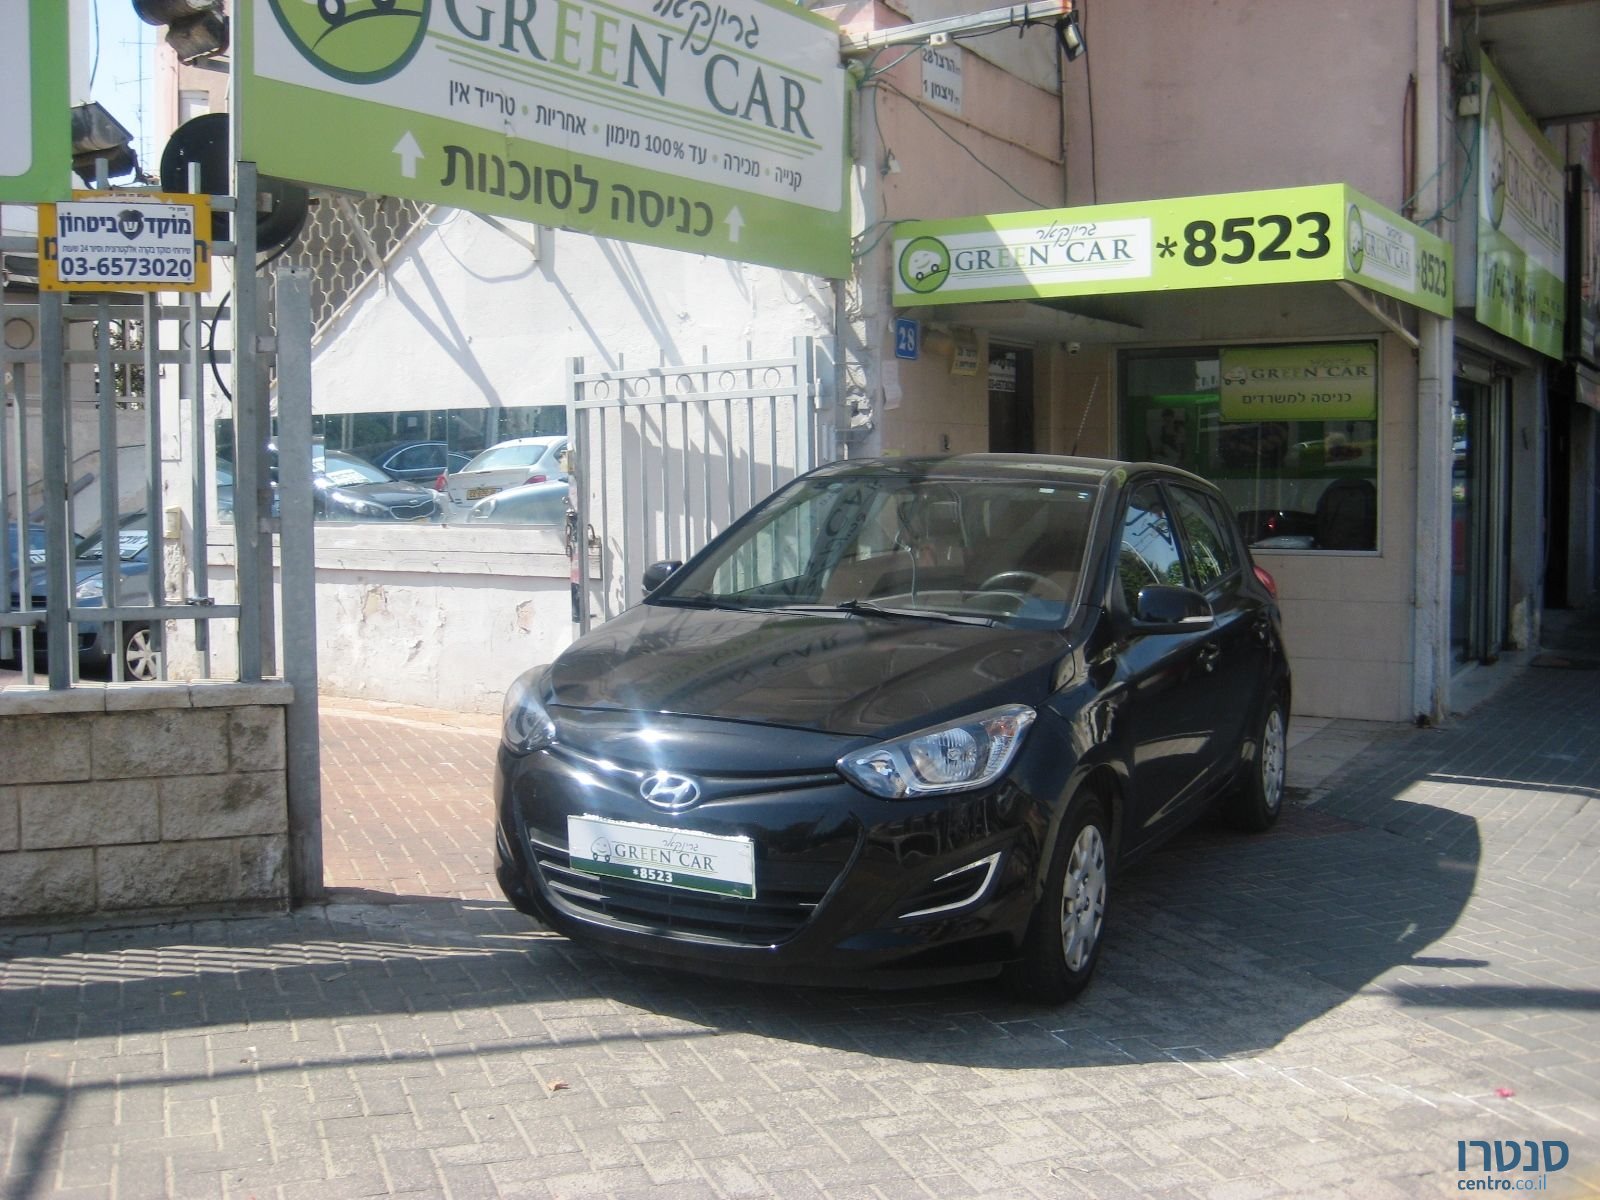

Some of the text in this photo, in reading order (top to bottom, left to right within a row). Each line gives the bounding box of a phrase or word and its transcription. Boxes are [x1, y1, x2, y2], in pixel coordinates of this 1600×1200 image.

[444, 0, 815, 140] GREEN CAR
[450, 79, 802, 192] קנייה מכירה עד 100% מימון אחריות טרייד אין
[440, 144, 714, 237] כניסה לסוכנות
[61, 256, 192, 277] 03-6573020
[955, 239, 1134, 272] GREEN CAR
[899, 326, 915, 351] 28
[1251, 365, 1369, 379] GREEN CAR
[1242, 391, 1352, 405] כניסה למשרדים
[614, 843, 714, 871] GREEN CAR
